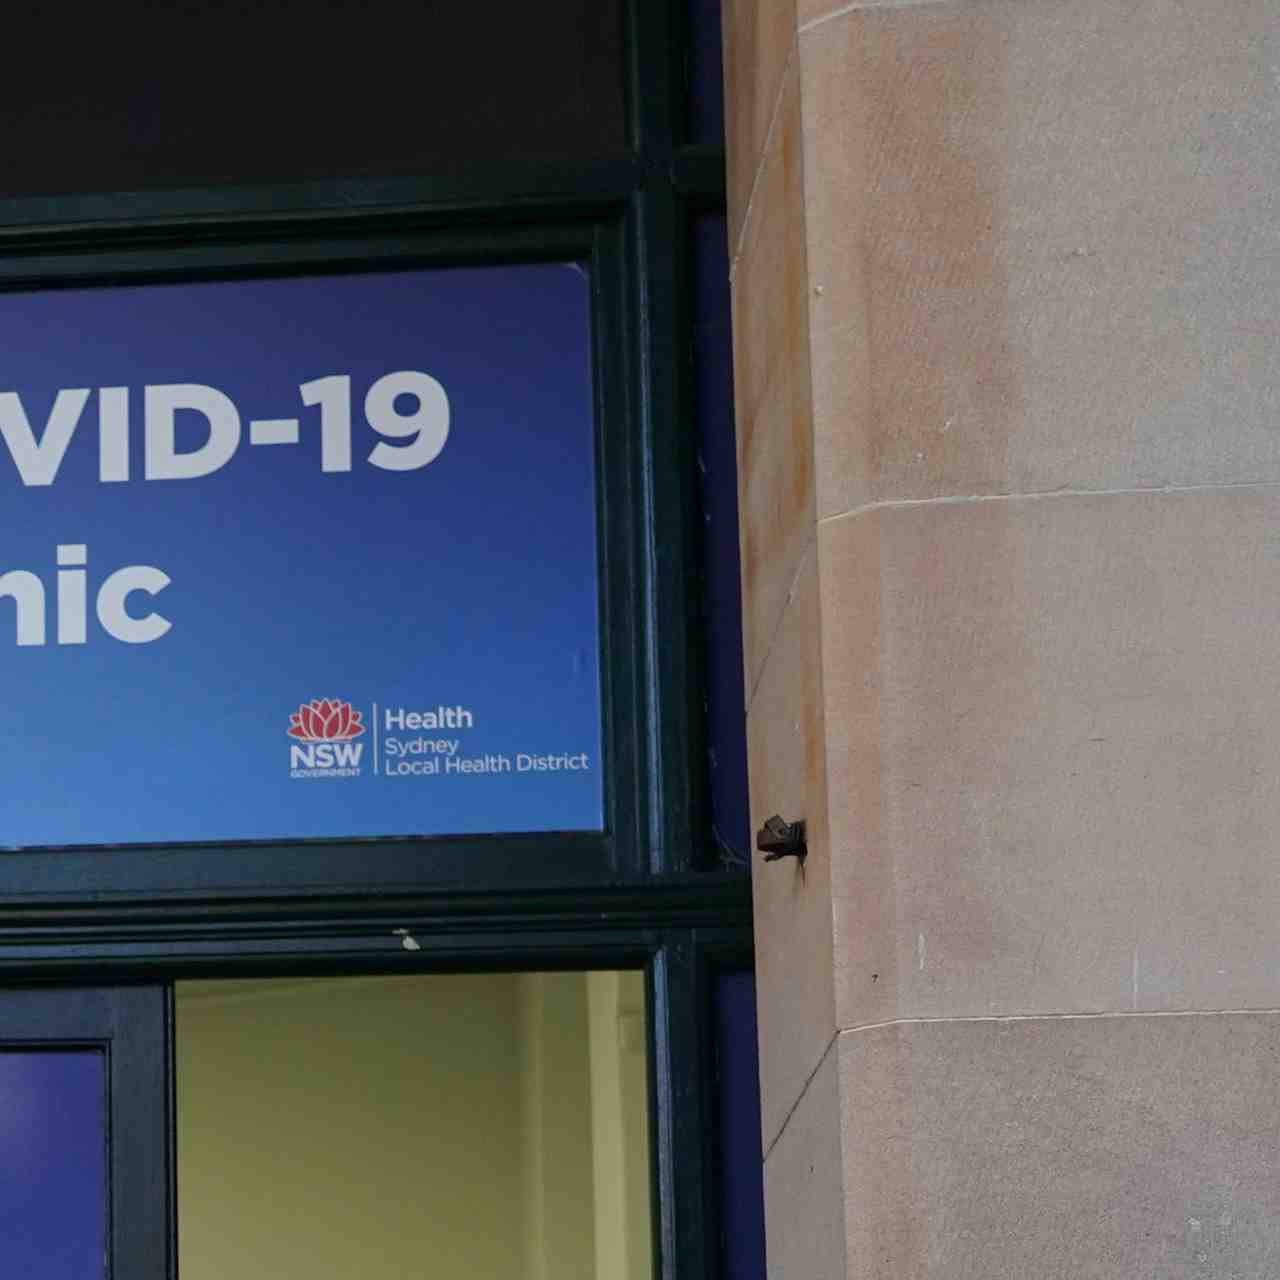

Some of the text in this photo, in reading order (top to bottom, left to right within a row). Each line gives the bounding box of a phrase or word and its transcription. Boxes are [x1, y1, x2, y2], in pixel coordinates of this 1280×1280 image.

[385, 706, 473, 731] Health
[290, 743, 363, 769] NSW
[385, 737, 460, 757] Sydney
[385, 752, 589, 776] Local Health District
